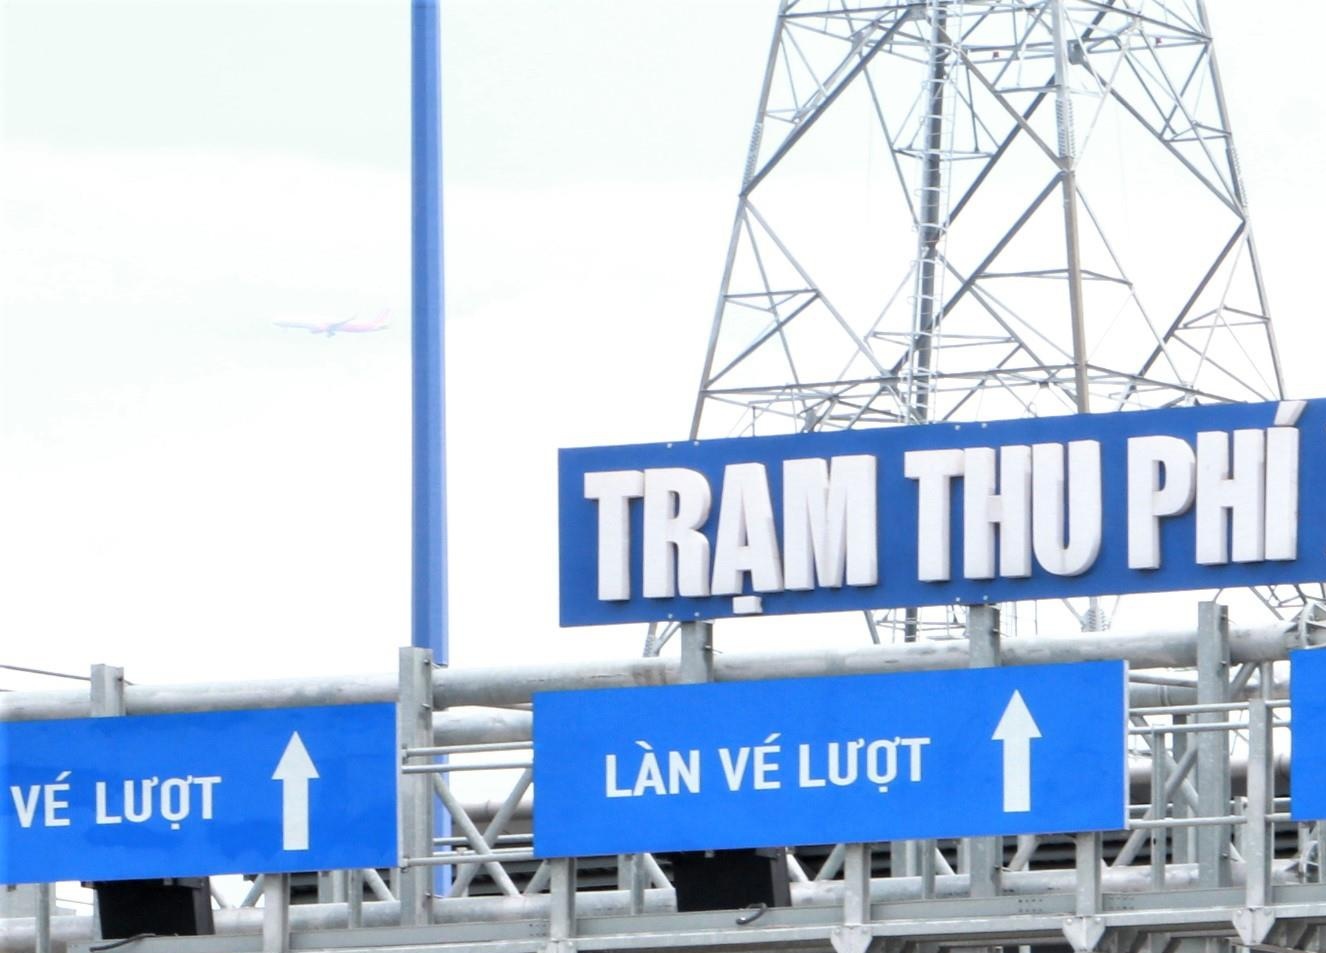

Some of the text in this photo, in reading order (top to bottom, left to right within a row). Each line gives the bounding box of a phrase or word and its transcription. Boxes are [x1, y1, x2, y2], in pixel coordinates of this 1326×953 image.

[584, 454, 878, 614] TRẠM
[904, 439, 1101, 581] THU
[1127, 401, 1307, 569] PHÍ
[605, 732, 931, 798] LÀN VÉ LƯỢT
[10, 771, 222, 830] VÉ LƯỢT
